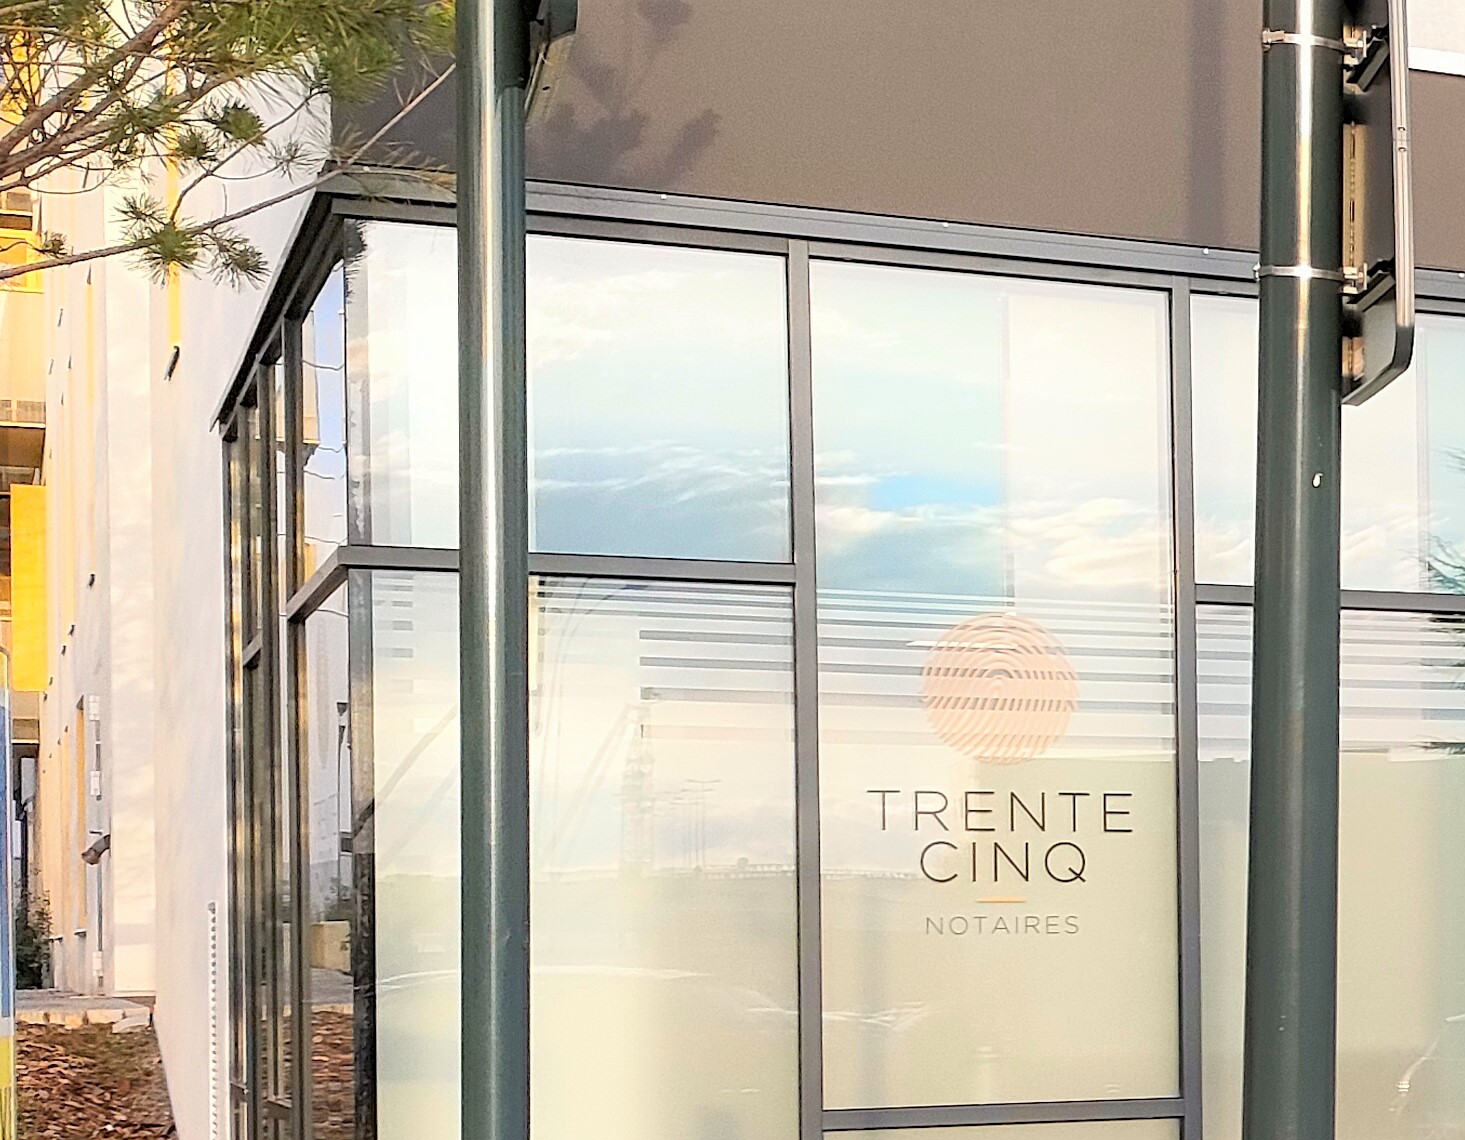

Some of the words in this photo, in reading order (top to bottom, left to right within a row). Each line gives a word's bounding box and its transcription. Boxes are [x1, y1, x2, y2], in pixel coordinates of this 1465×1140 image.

[866, 790, 1133, 833] TRENTE
[920, 841, 1086, 883] CINQ
[926, 915, 1080, 935] NOTAIRES
